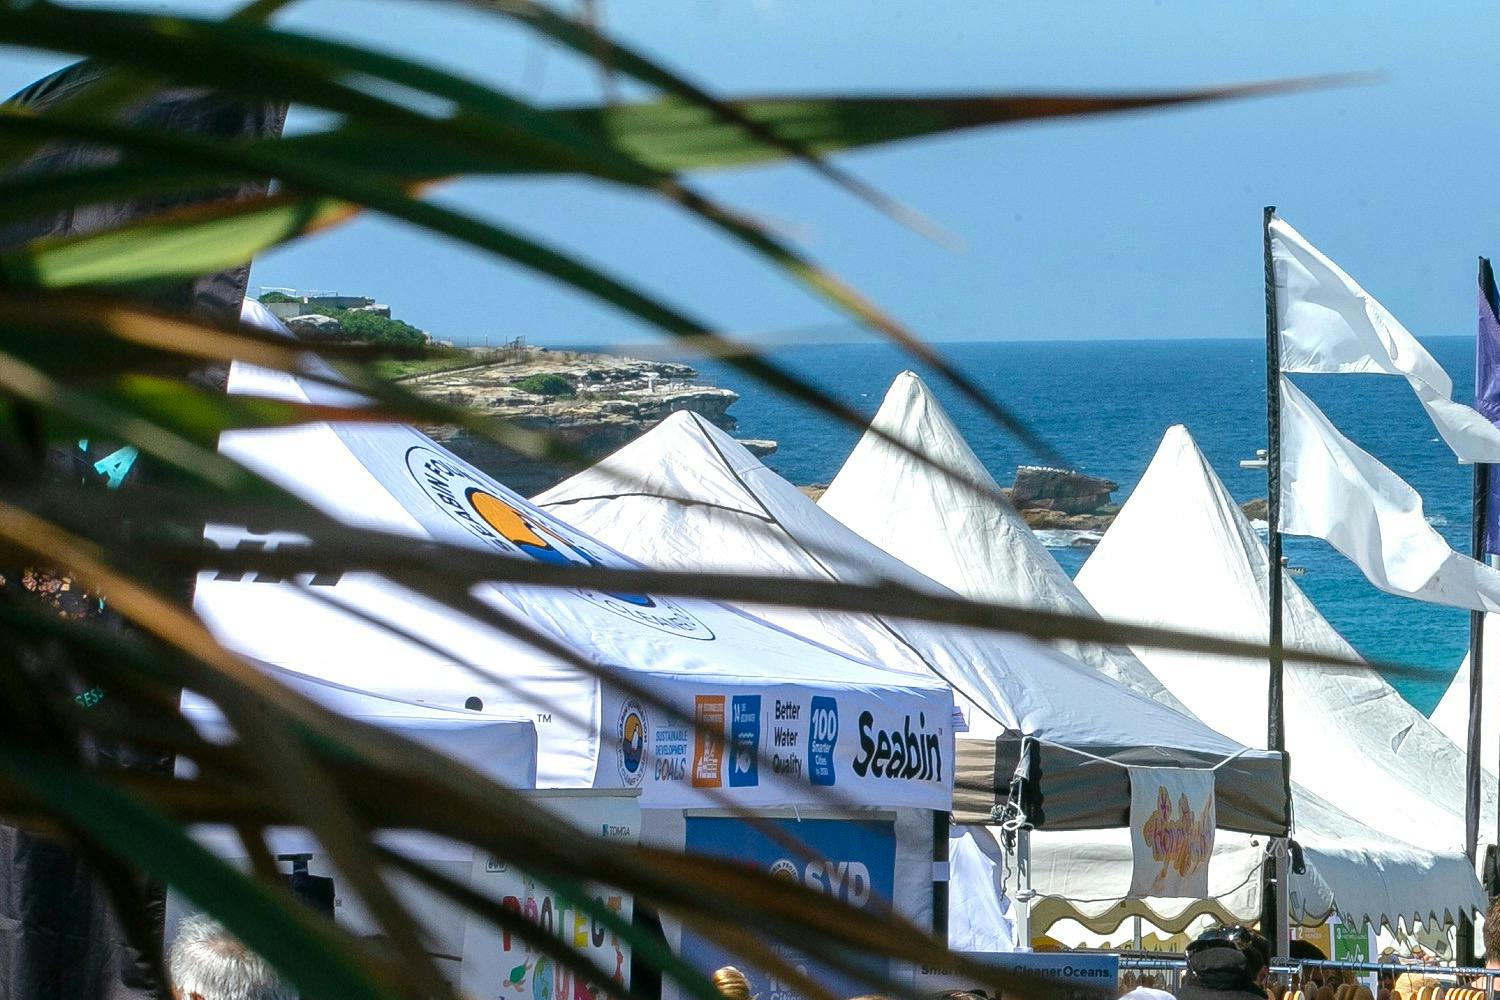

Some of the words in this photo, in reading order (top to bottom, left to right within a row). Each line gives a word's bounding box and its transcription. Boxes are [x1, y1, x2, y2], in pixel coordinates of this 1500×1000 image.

[775, 700, 800, 719] Better
[812, 708, 837, 741] 100
[656, 731, 688, 742] SUSTAINABLE
[774, 727, 798, 747] Water
[853, 711, 941, 782] Seabin
[656, 745, 688, 756] DEVELOPMENT
[655, 758, 687, 781] GOALS
[773, 753, 802, 778] Quality
[804, 861, 871, 909] SYD
[1062, 966, 1113, 978] Oceans.
